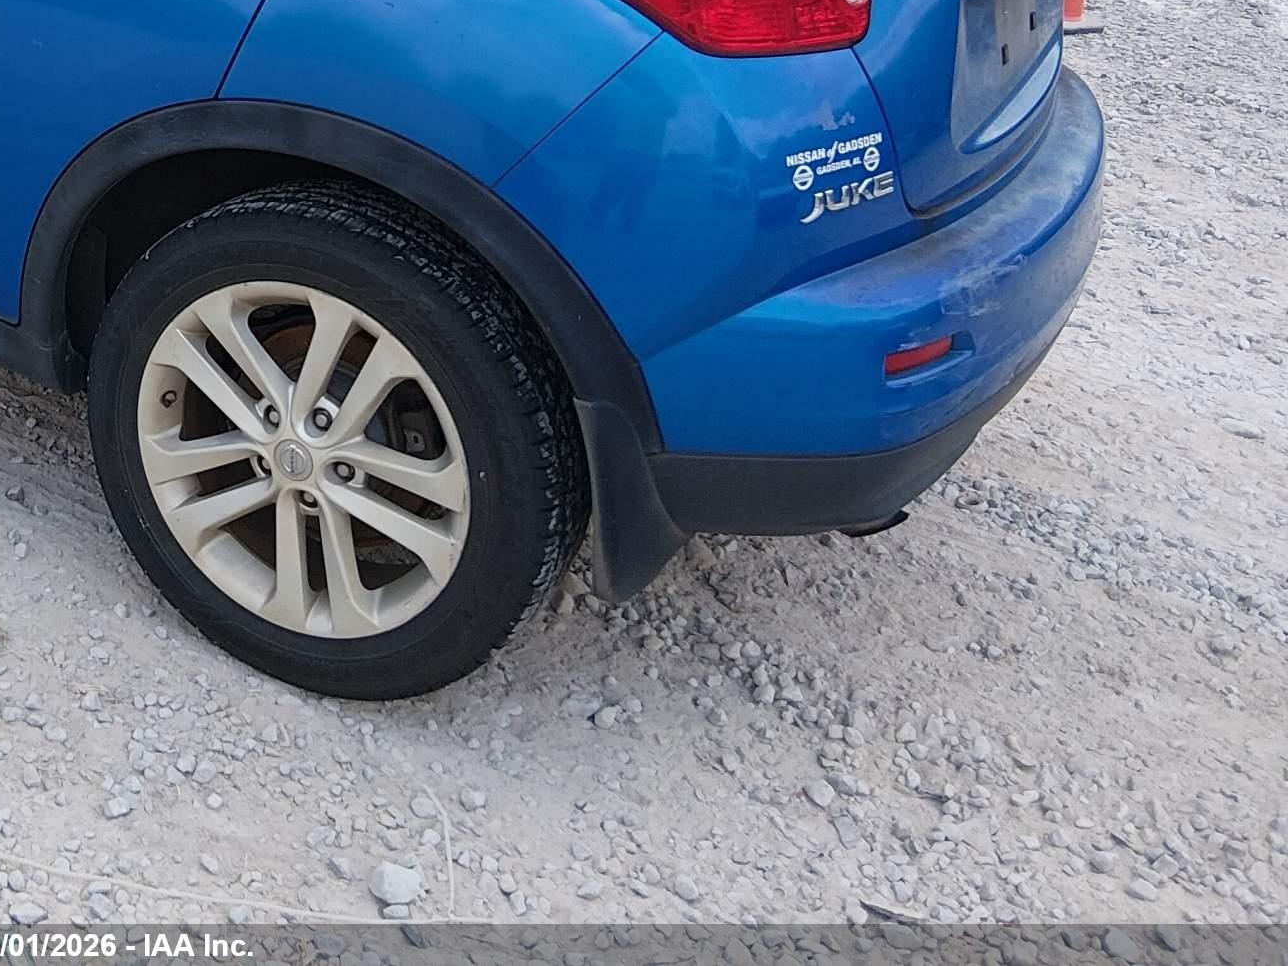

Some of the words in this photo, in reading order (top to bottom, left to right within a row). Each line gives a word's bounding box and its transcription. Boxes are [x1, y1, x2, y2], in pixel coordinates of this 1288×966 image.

[786, 147, 826, 167] NISSAN
[826, 140, 838, 163] of
[838, 132, 883, 154] GADSDEN
[799, 171, 895, 224] JUKE
